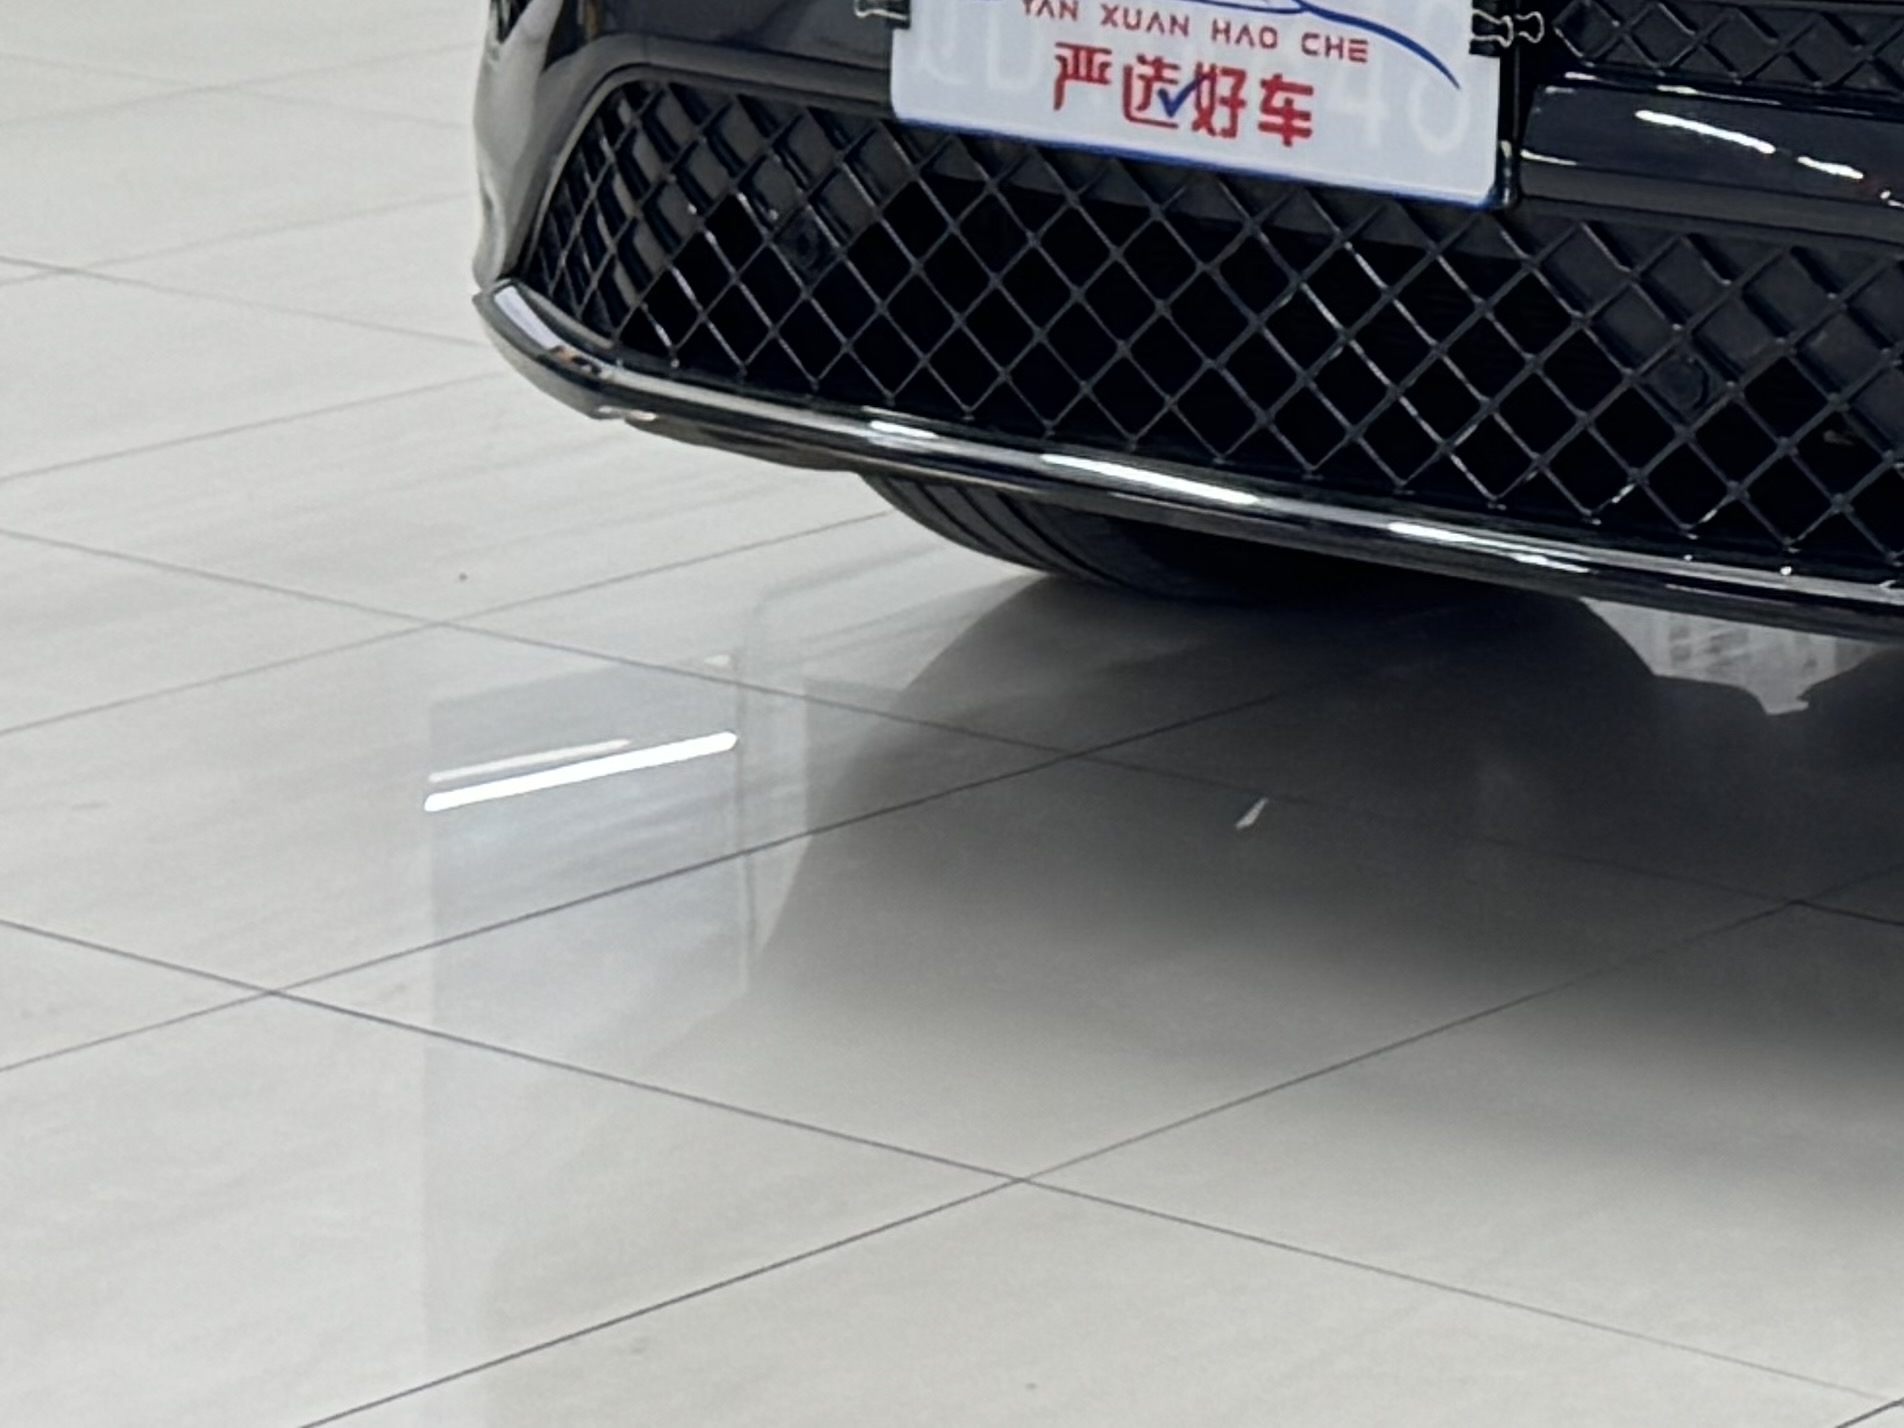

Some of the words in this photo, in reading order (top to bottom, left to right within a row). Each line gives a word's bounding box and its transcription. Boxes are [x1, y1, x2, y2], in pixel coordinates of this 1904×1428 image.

[1100, 3, 1190, 38] XUAN
[1210, 18, 1279, 50] HAO
[1300, 31, 1369, 64] CHE
[1053, 41, 1315, 148] 严选好车
